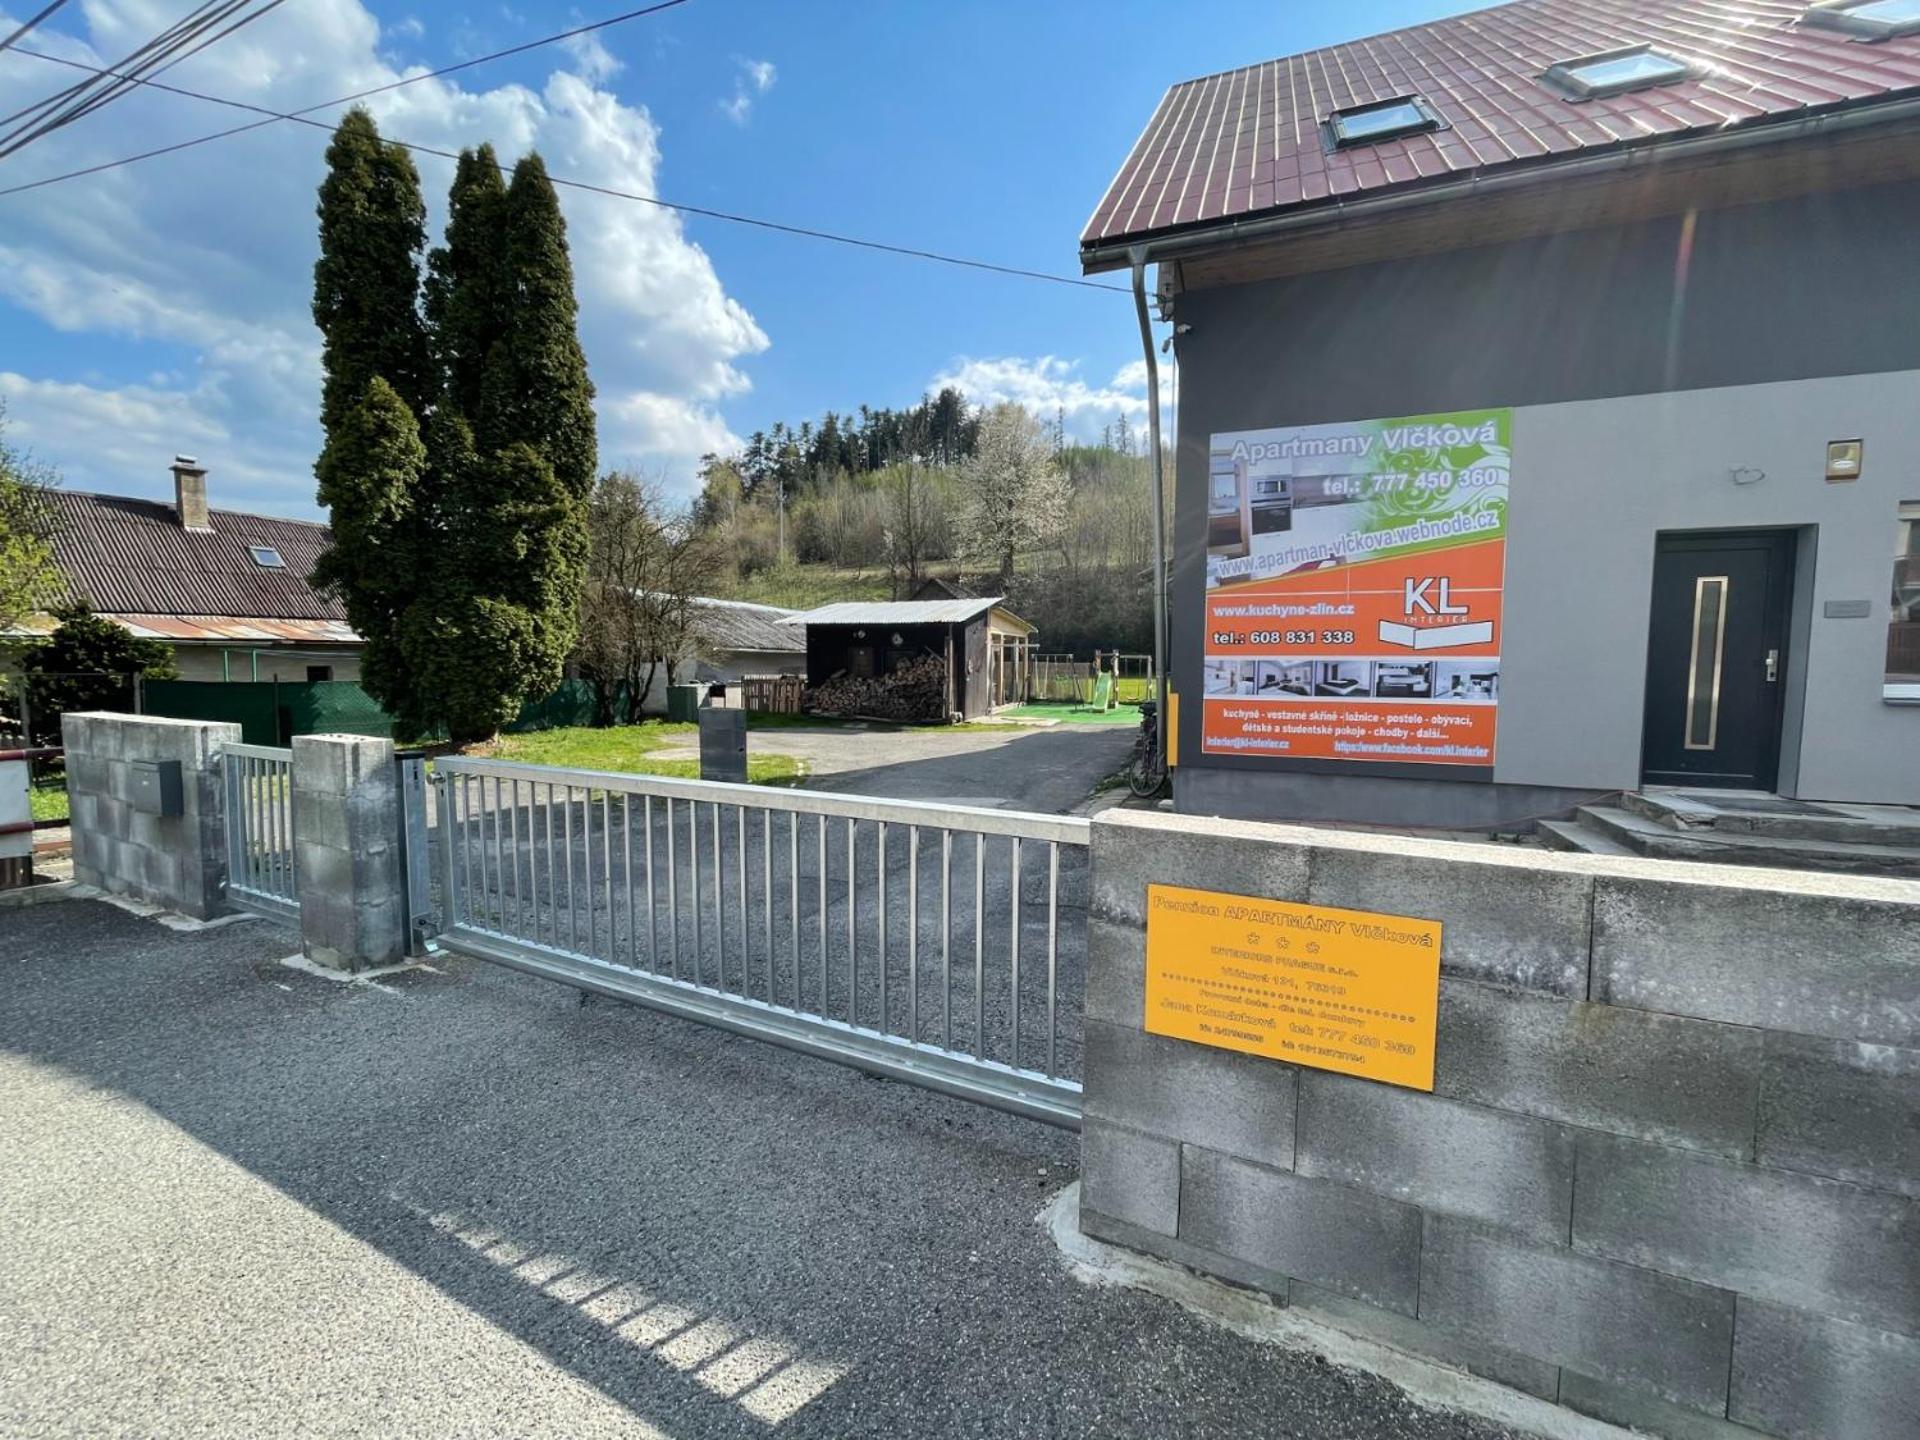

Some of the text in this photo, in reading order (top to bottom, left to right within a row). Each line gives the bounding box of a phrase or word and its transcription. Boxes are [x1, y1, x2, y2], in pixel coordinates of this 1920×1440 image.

[1230, 422, 1496, 464] Apartmany Vlčková
[1323, 467, 1498, 496] tel.: 777 450 360
[1403, 576, 1469, 615] KL
[1250, 631, 1281, 644] 608
[1285, 631, 1316, 644] 831
[1322, 630, 1354, 644] 338
[1335, 725, 1366, 738] pokoje
[1374, 726, 1408, 740] chodby
[1345, 712, 1379, 723] ložnice
[1387, 713, 1423, 726] postele
[1224, 905, 1345, 934] APARTMÁNY
[1352, 925, 1433, 947] Vlčková
